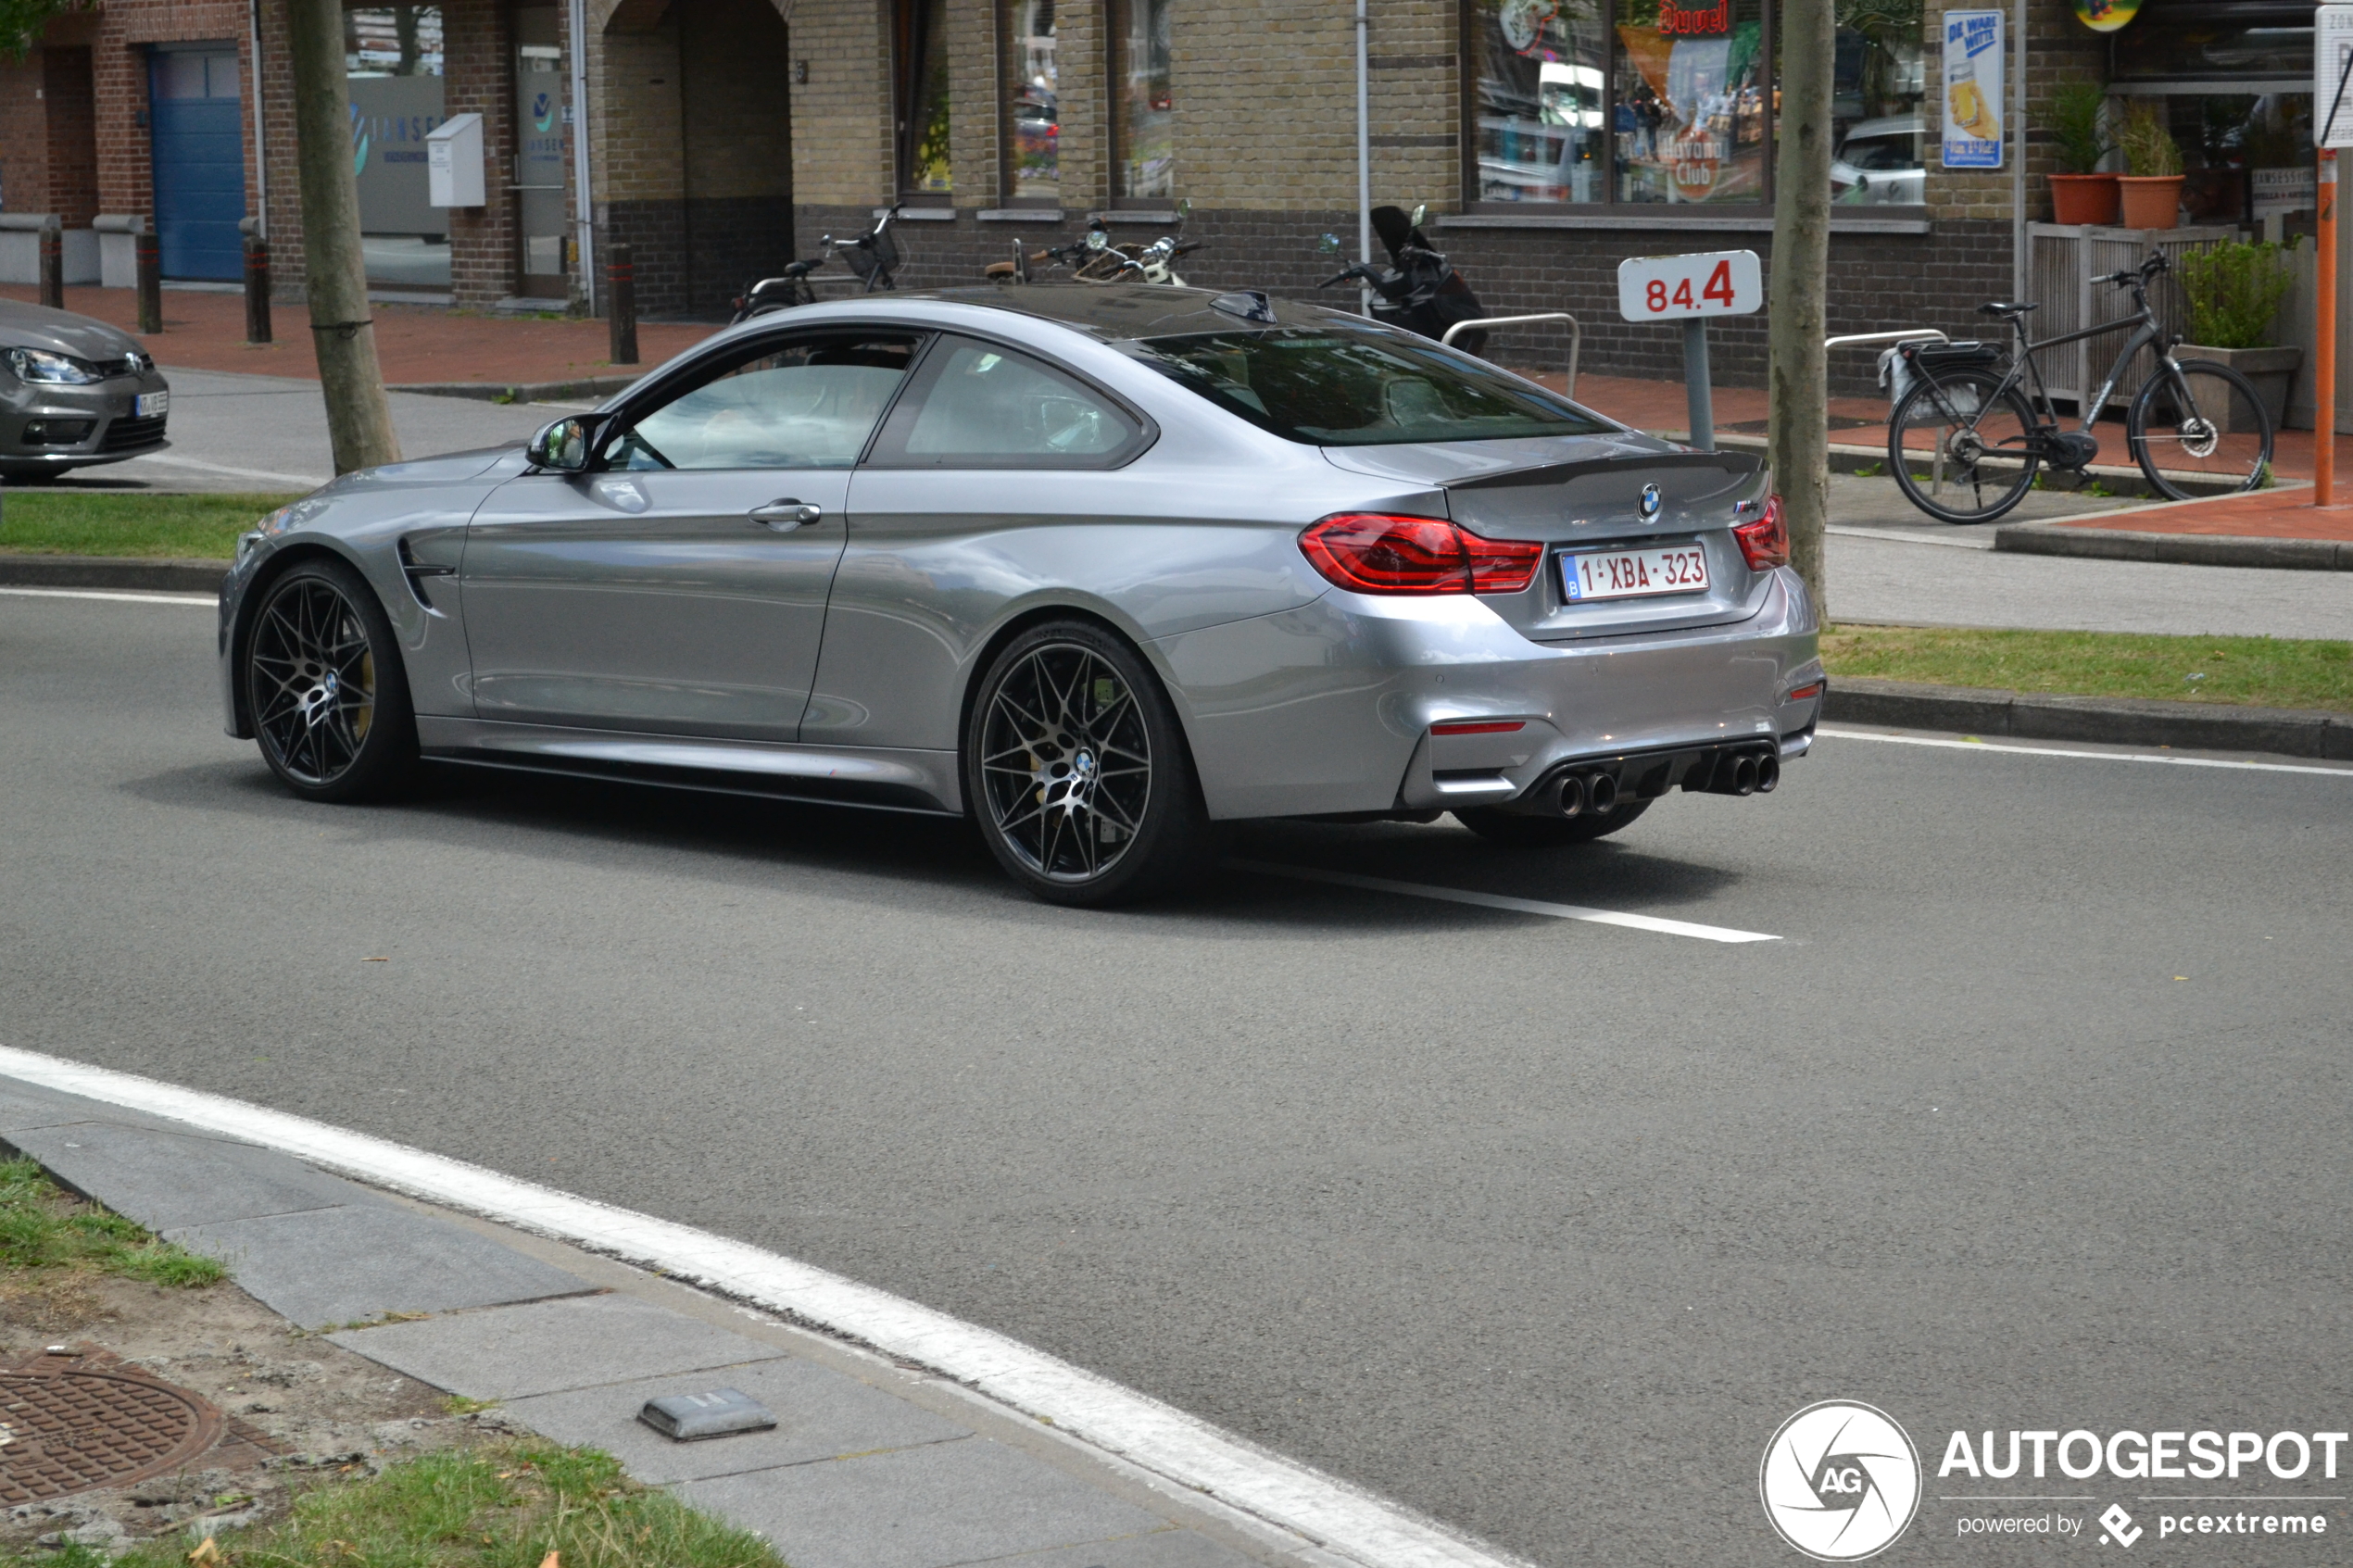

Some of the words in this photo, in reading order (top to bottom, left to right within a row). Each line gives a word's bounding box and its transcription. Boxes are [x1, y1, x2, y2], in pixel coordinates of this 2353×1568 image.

[1658, 0, 1729, 34] Duvel
[1948, 20, 1964, 44] DE
[1967, 16, 1997, 32] WARE
[1965, 29, 1994, 50] WITTE
[1664, 136, 1722, 159] Havana
[1676, 162, 1711, 185] Club
[1646, 259, 1735, 313] 84.4
[1568, 581, 1579, 596] B
